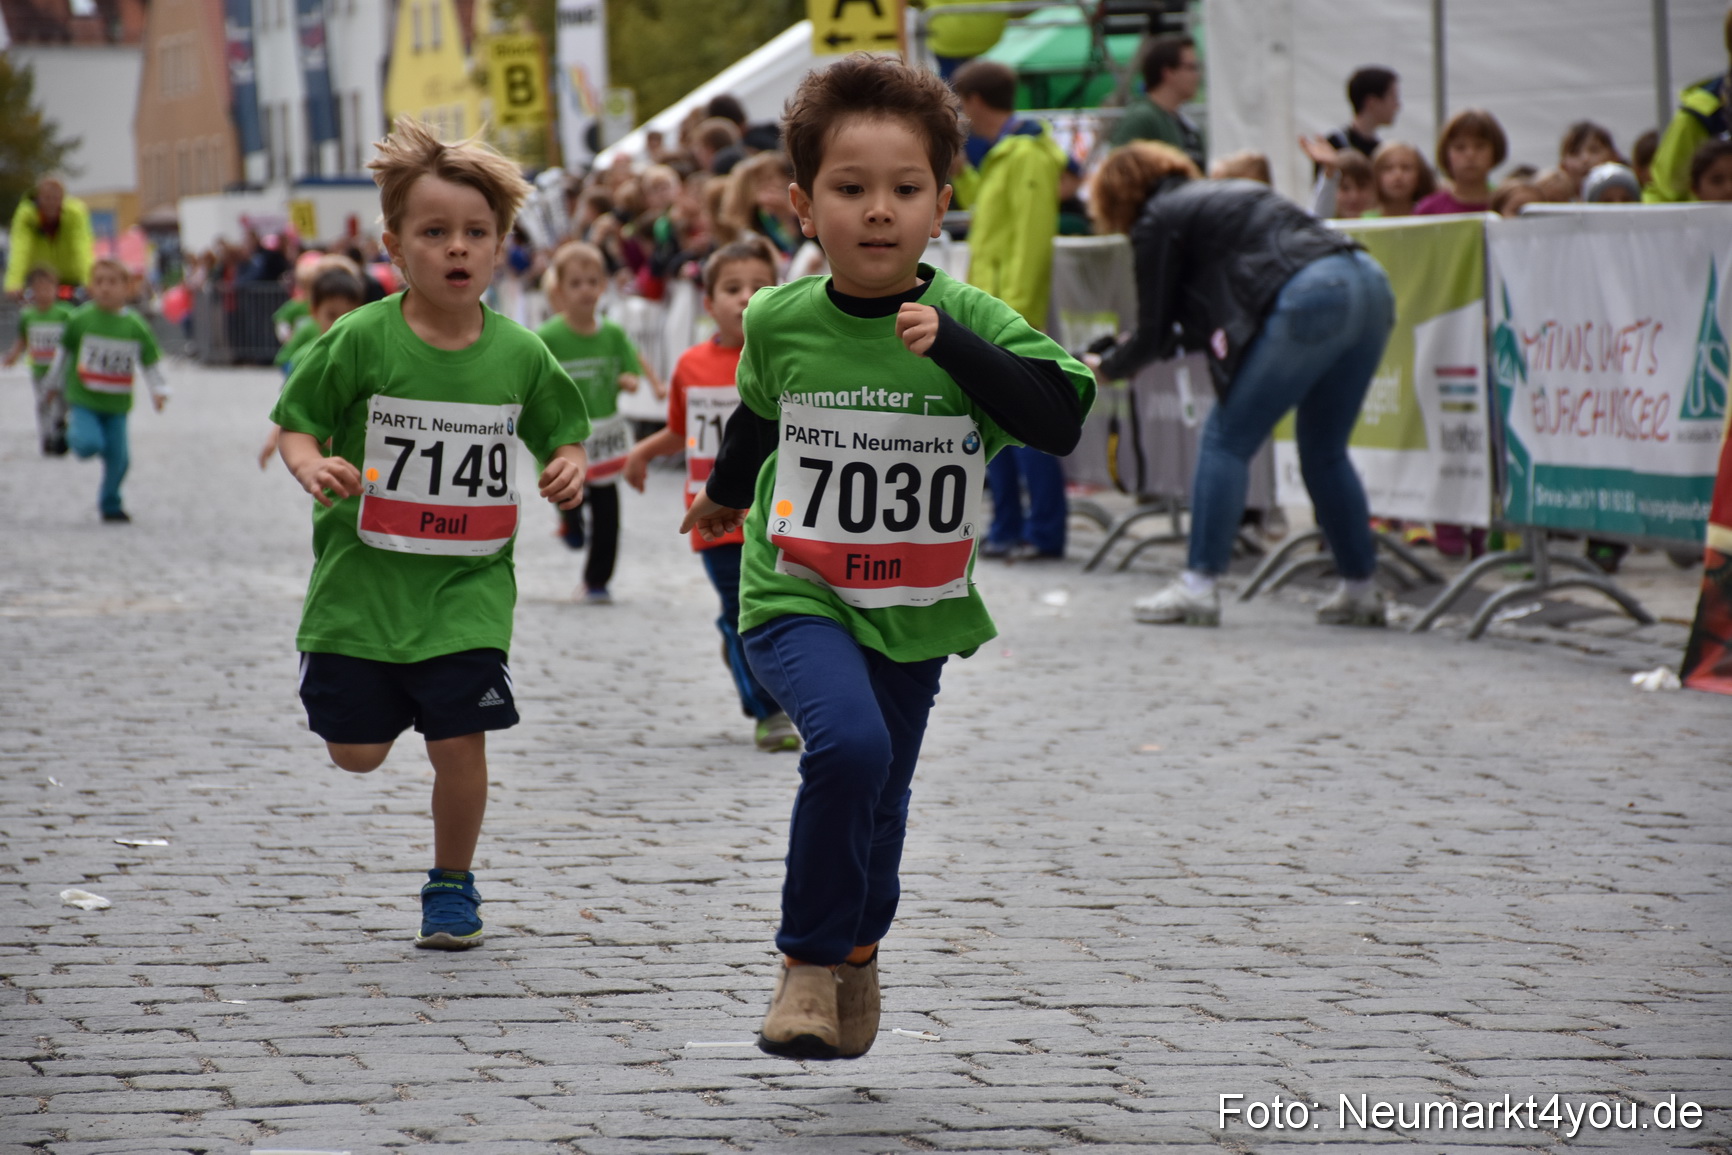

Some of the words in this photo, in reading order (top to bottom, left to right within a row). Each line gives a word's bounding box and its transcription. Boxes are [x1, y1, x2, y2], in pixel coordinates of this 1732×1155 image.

[505, 63, 535, 107] B
[372, 411, 427, 431] PARTL
[432, 418, 504, 435] Neumarkt
[785, 424, 846, 449] PARTL
[852, 432, 954, 454] Neumarkt
[384, 436, 508, 498] 7149
[799, 456, 967, 534] 7030
[420, 512, 468, 535] Paul
[777, 521, 786, 533] 2
[963, 525, 970, 537] K
[845, 553, 901, 581] Finn
[478, 698, 505, 708] adidas
